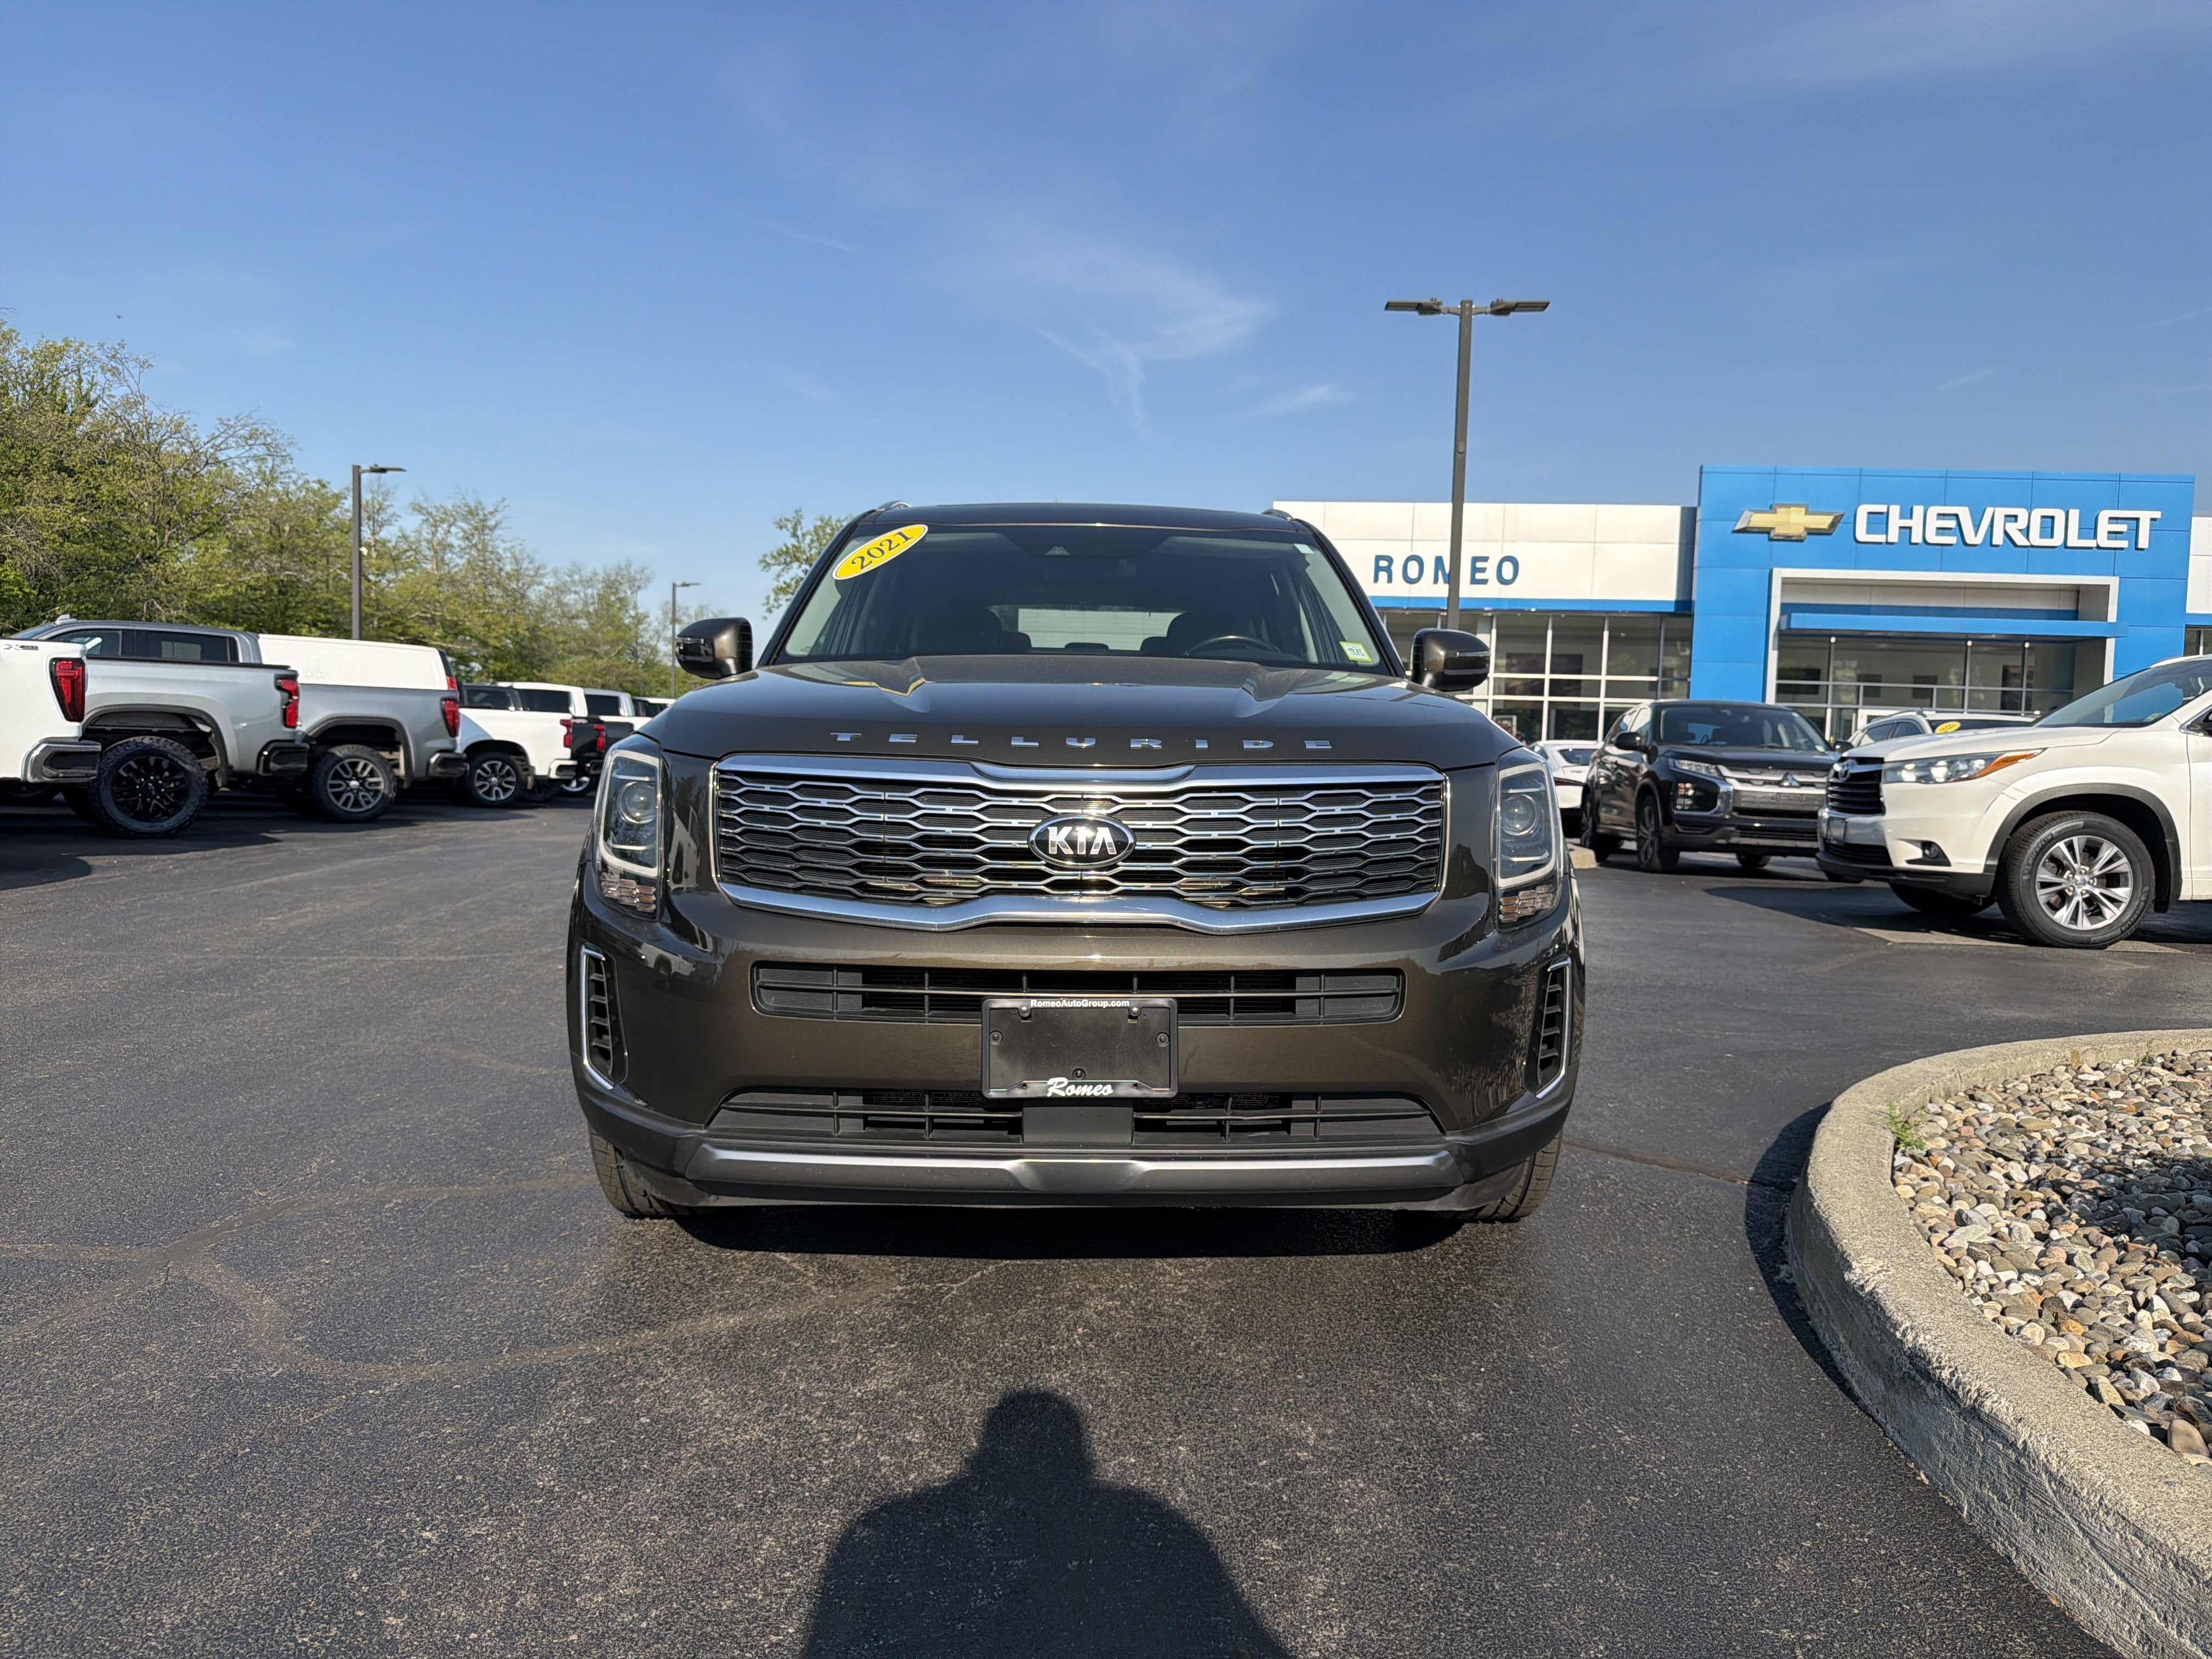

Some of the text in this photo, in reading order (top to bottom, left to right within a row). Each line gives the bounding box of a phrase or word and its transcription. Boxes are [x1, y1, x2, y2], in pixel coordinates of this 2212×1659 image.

[1855, 504, 2162, 549] CHEVROLET
[851, 531, 913, 570] 2021
[1373, 555, 1520, 585] ROMEO
[830, 732, 1332, 749] TELLURIDE
[1048, 826, 1117, 855] KIA
[1030, 999, 1130, 1008] RomeoAutoGroup.com
[1047, 1077, 1113, 1097] Romeo
